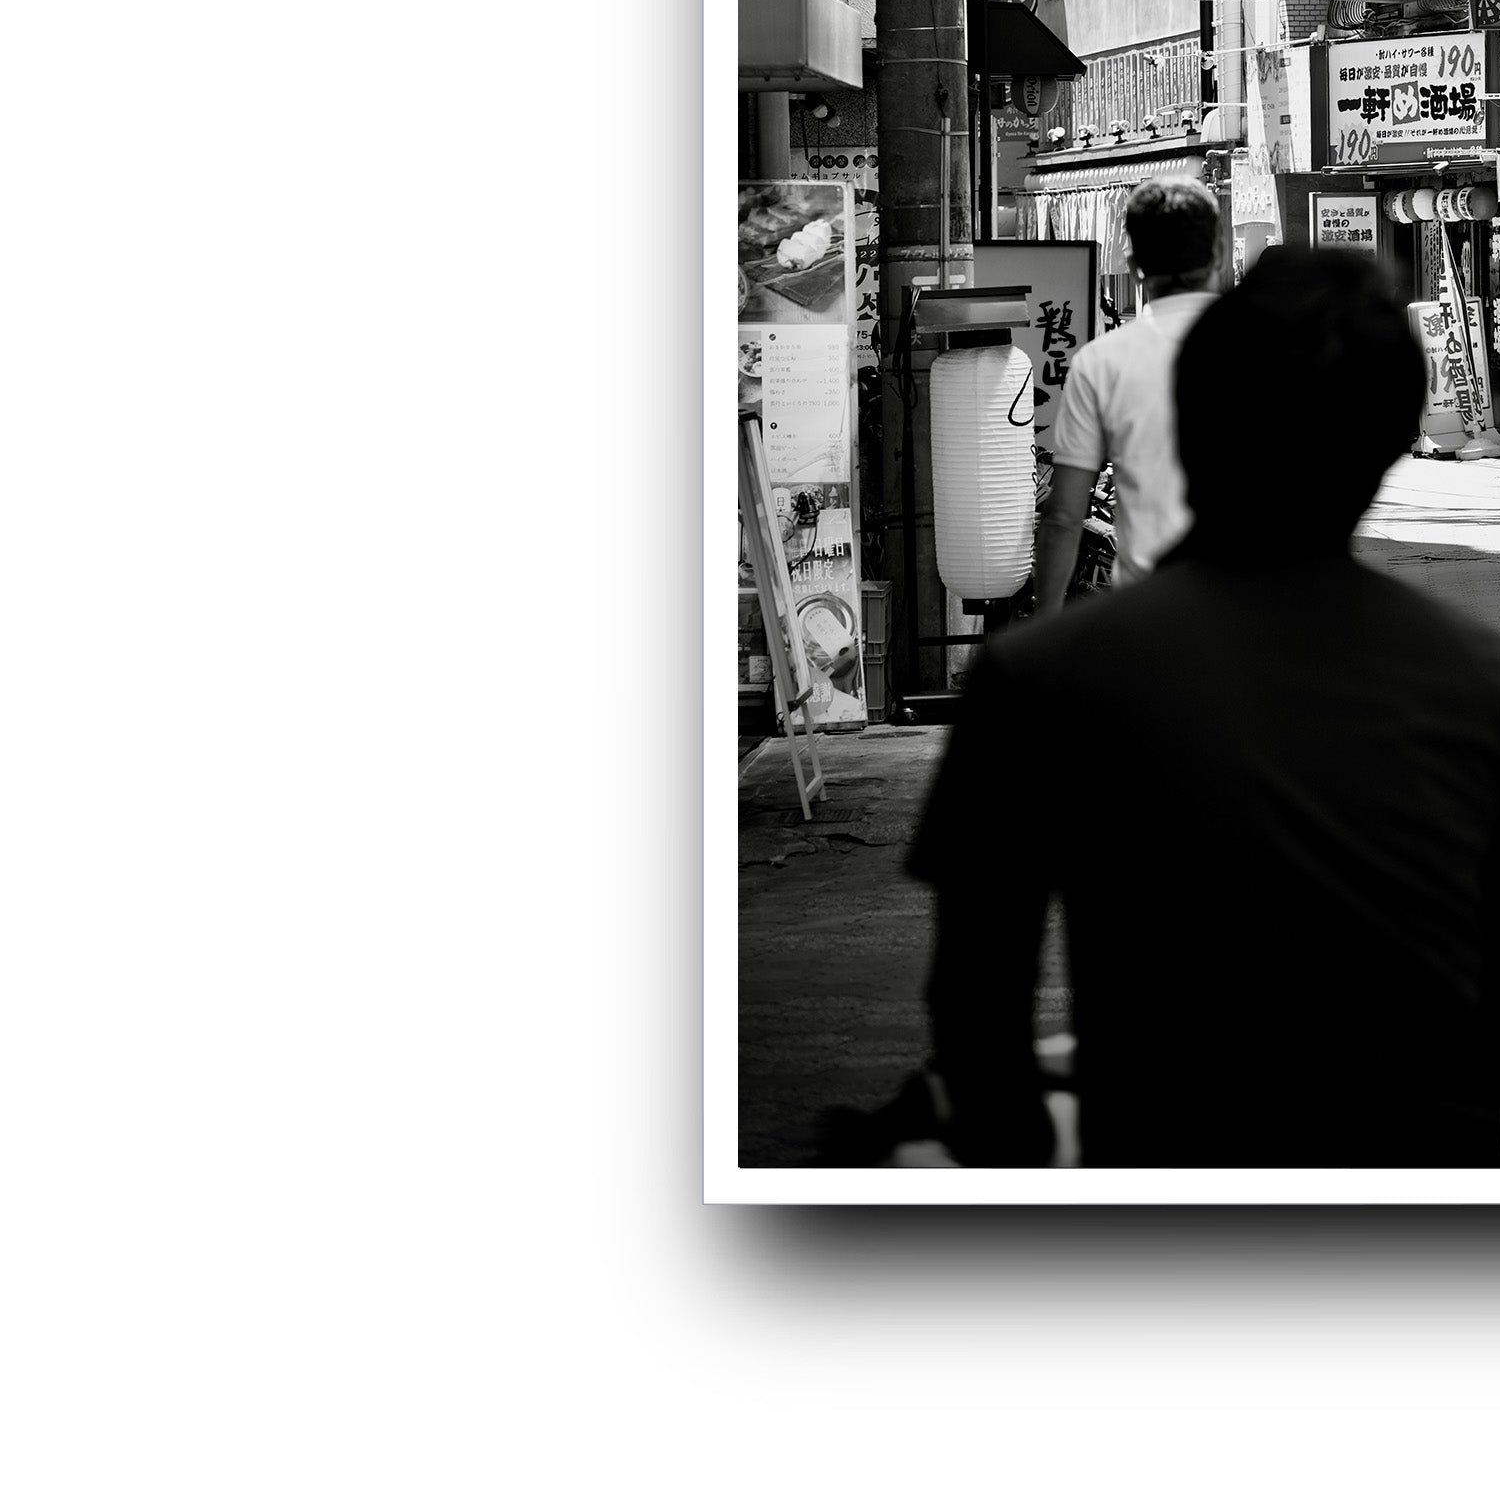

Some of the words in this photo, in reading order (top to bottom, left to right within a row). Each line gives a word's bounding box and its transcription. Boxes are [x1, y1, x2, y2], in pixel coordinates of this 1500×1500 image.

[1337, 80, 1477, 126] 一軒め酒場
